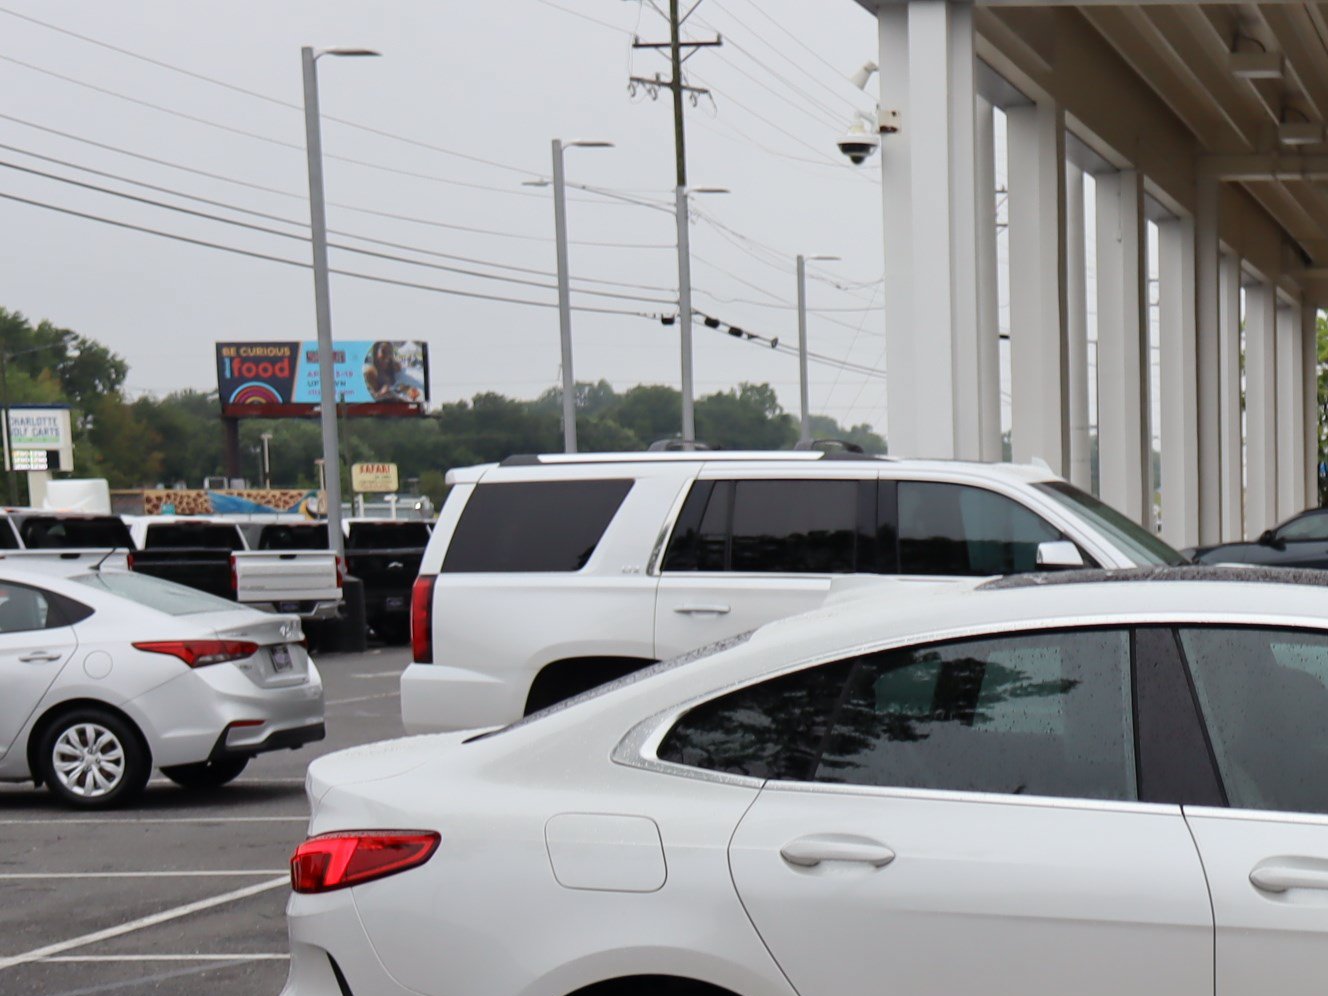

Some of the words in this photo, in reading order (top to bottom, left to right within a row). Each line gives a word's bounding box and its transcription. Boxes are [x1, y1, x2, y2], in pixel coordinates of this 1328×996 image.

[222, 346, 237, 356] BE
[240, 346, 291, 356] CURIOUS
[232, 357, 289, 379] food
